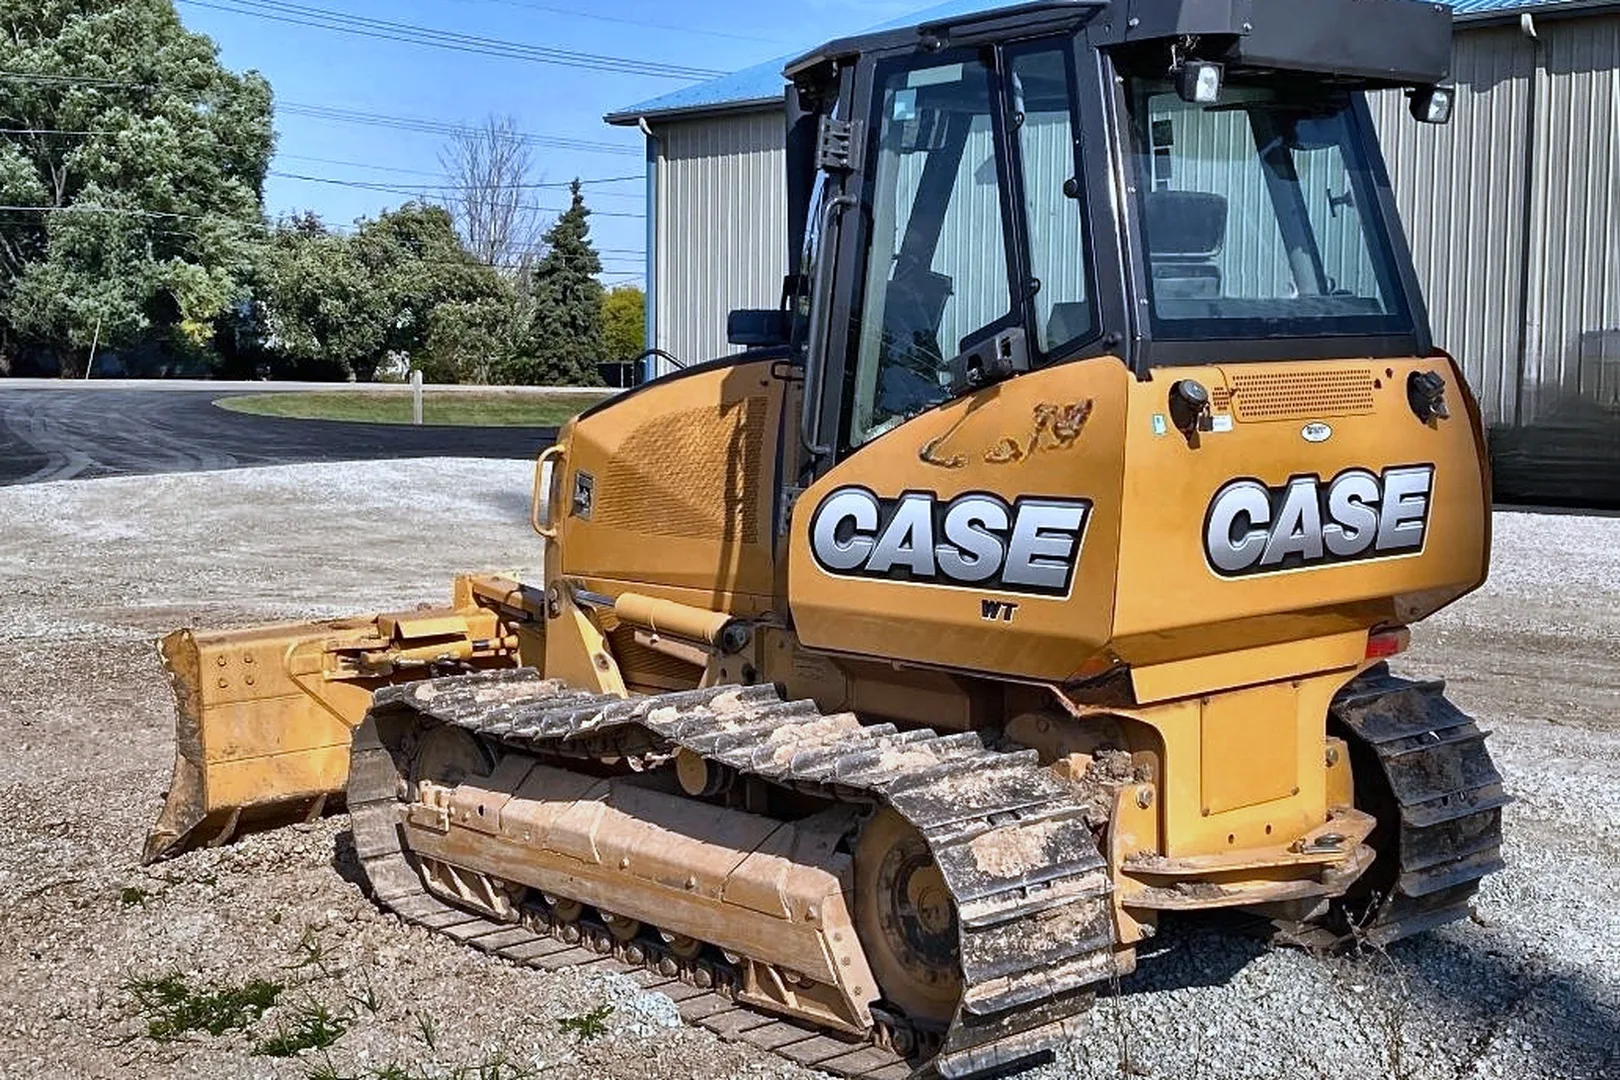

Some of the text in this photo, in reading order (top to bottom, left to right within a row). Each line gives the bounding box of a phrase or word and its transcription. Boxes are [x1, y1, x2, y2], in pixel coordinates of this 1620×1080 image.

[811, 486, 1088, 590] CASE
[1206, 466, 1433, 572] CASE
[981, 599, 1019, 622] WT
